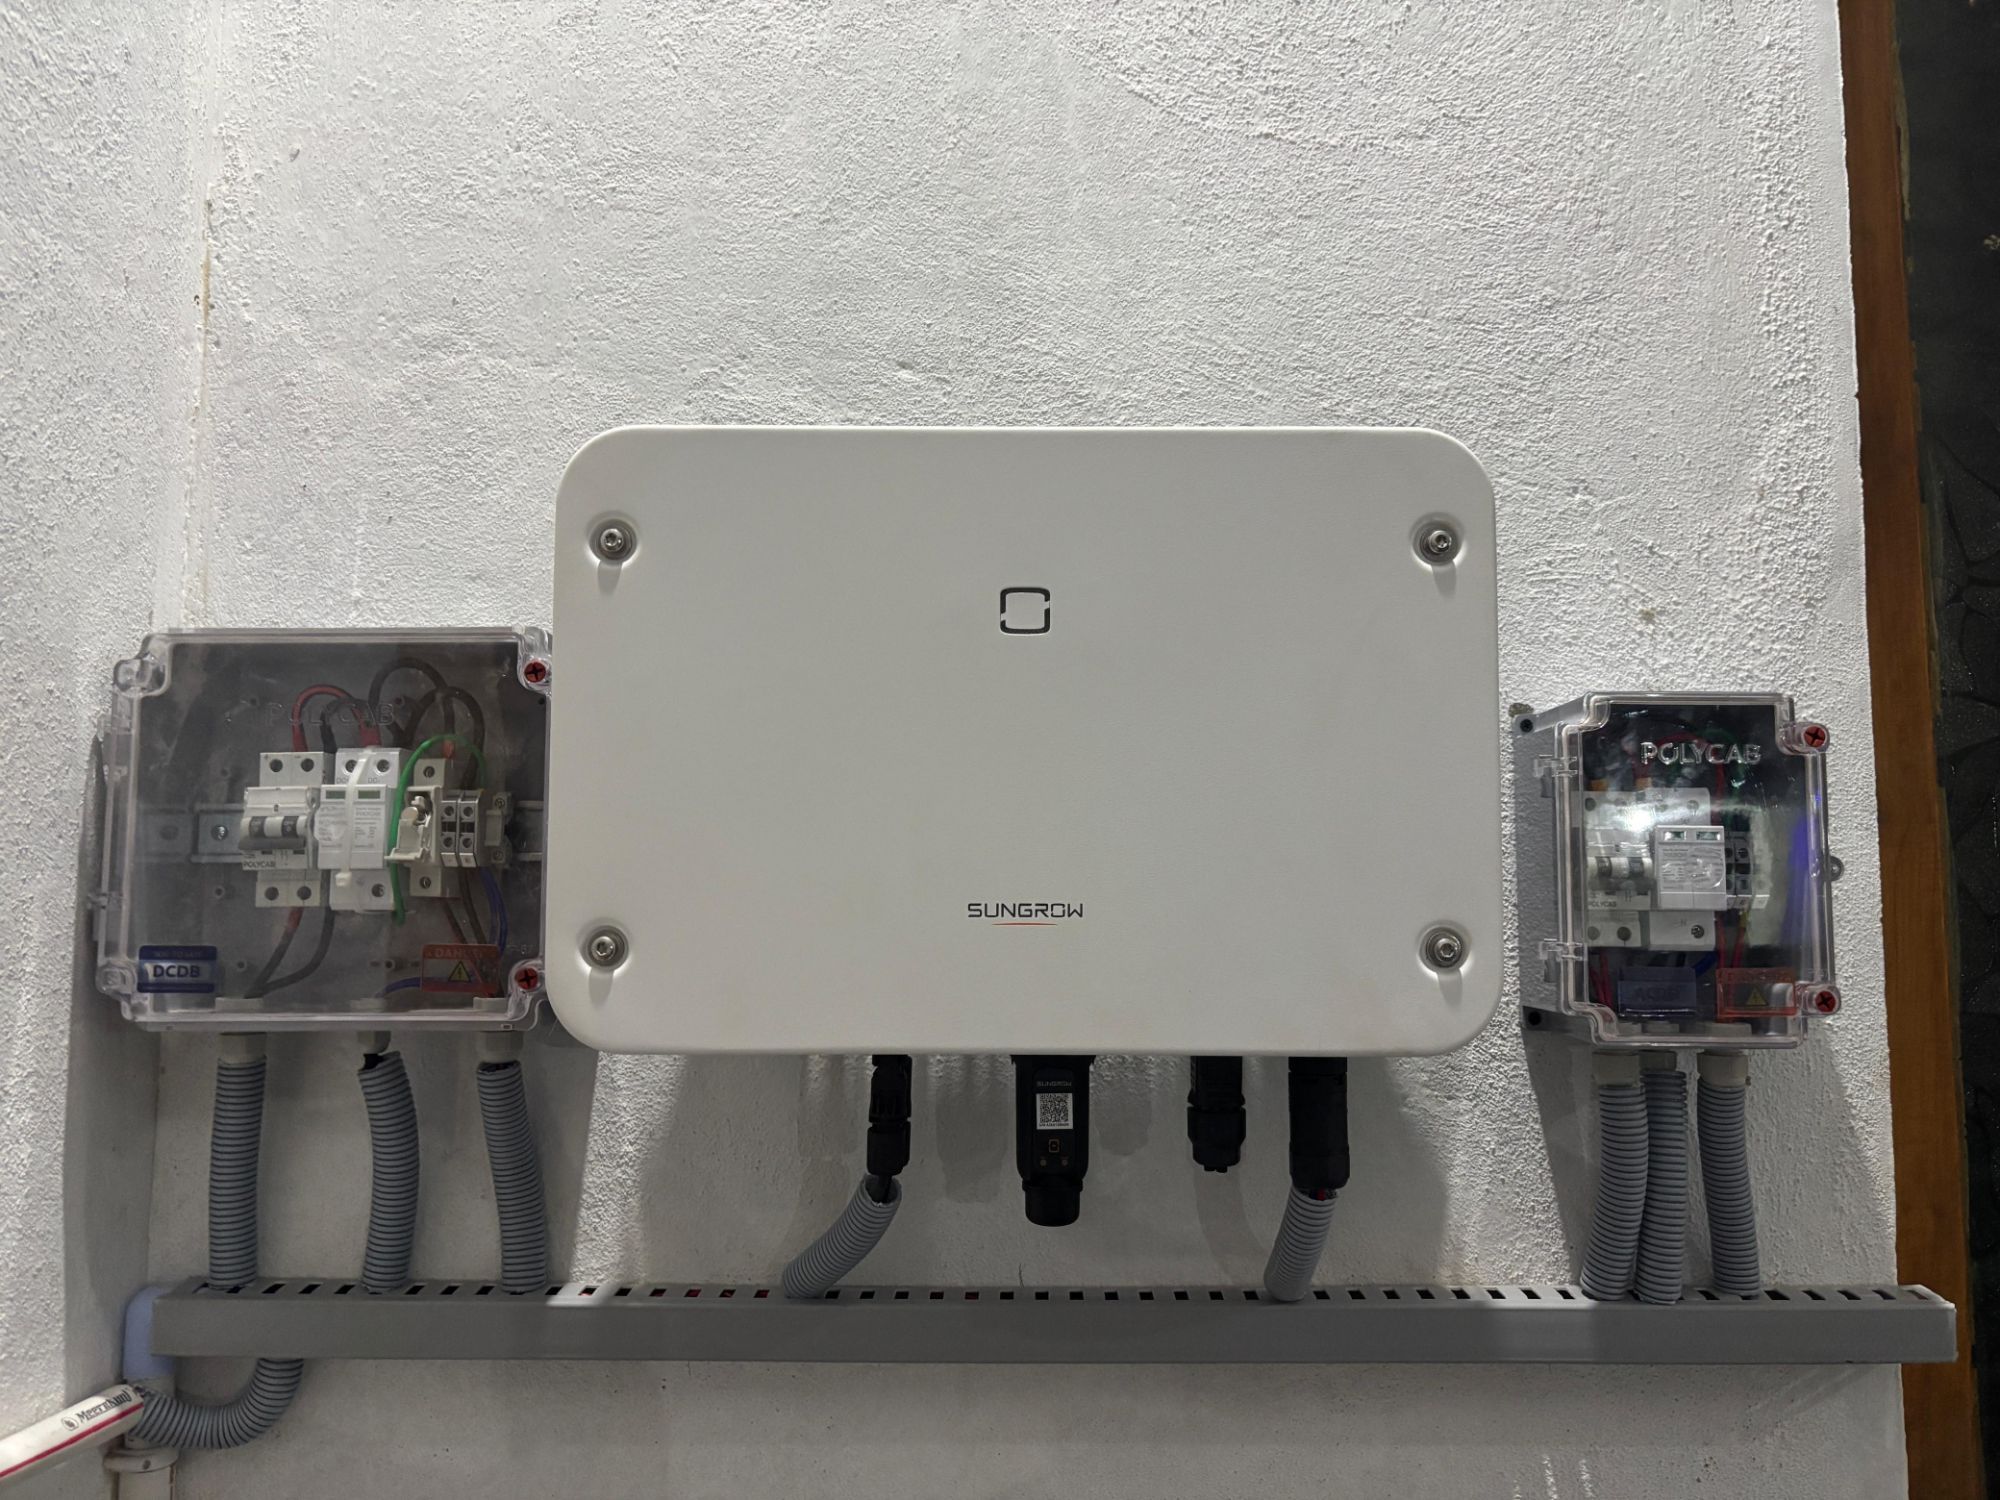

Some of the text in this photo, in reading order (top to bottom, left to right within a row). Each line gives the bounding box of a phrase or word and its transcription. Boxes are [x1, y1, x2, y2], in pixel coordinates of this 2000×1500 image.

[1640, 741, 1761, 764] POLYCAB
[967, 903, 1083, 918] SUNGROW
[153, 964, 201, 978] DCDB
